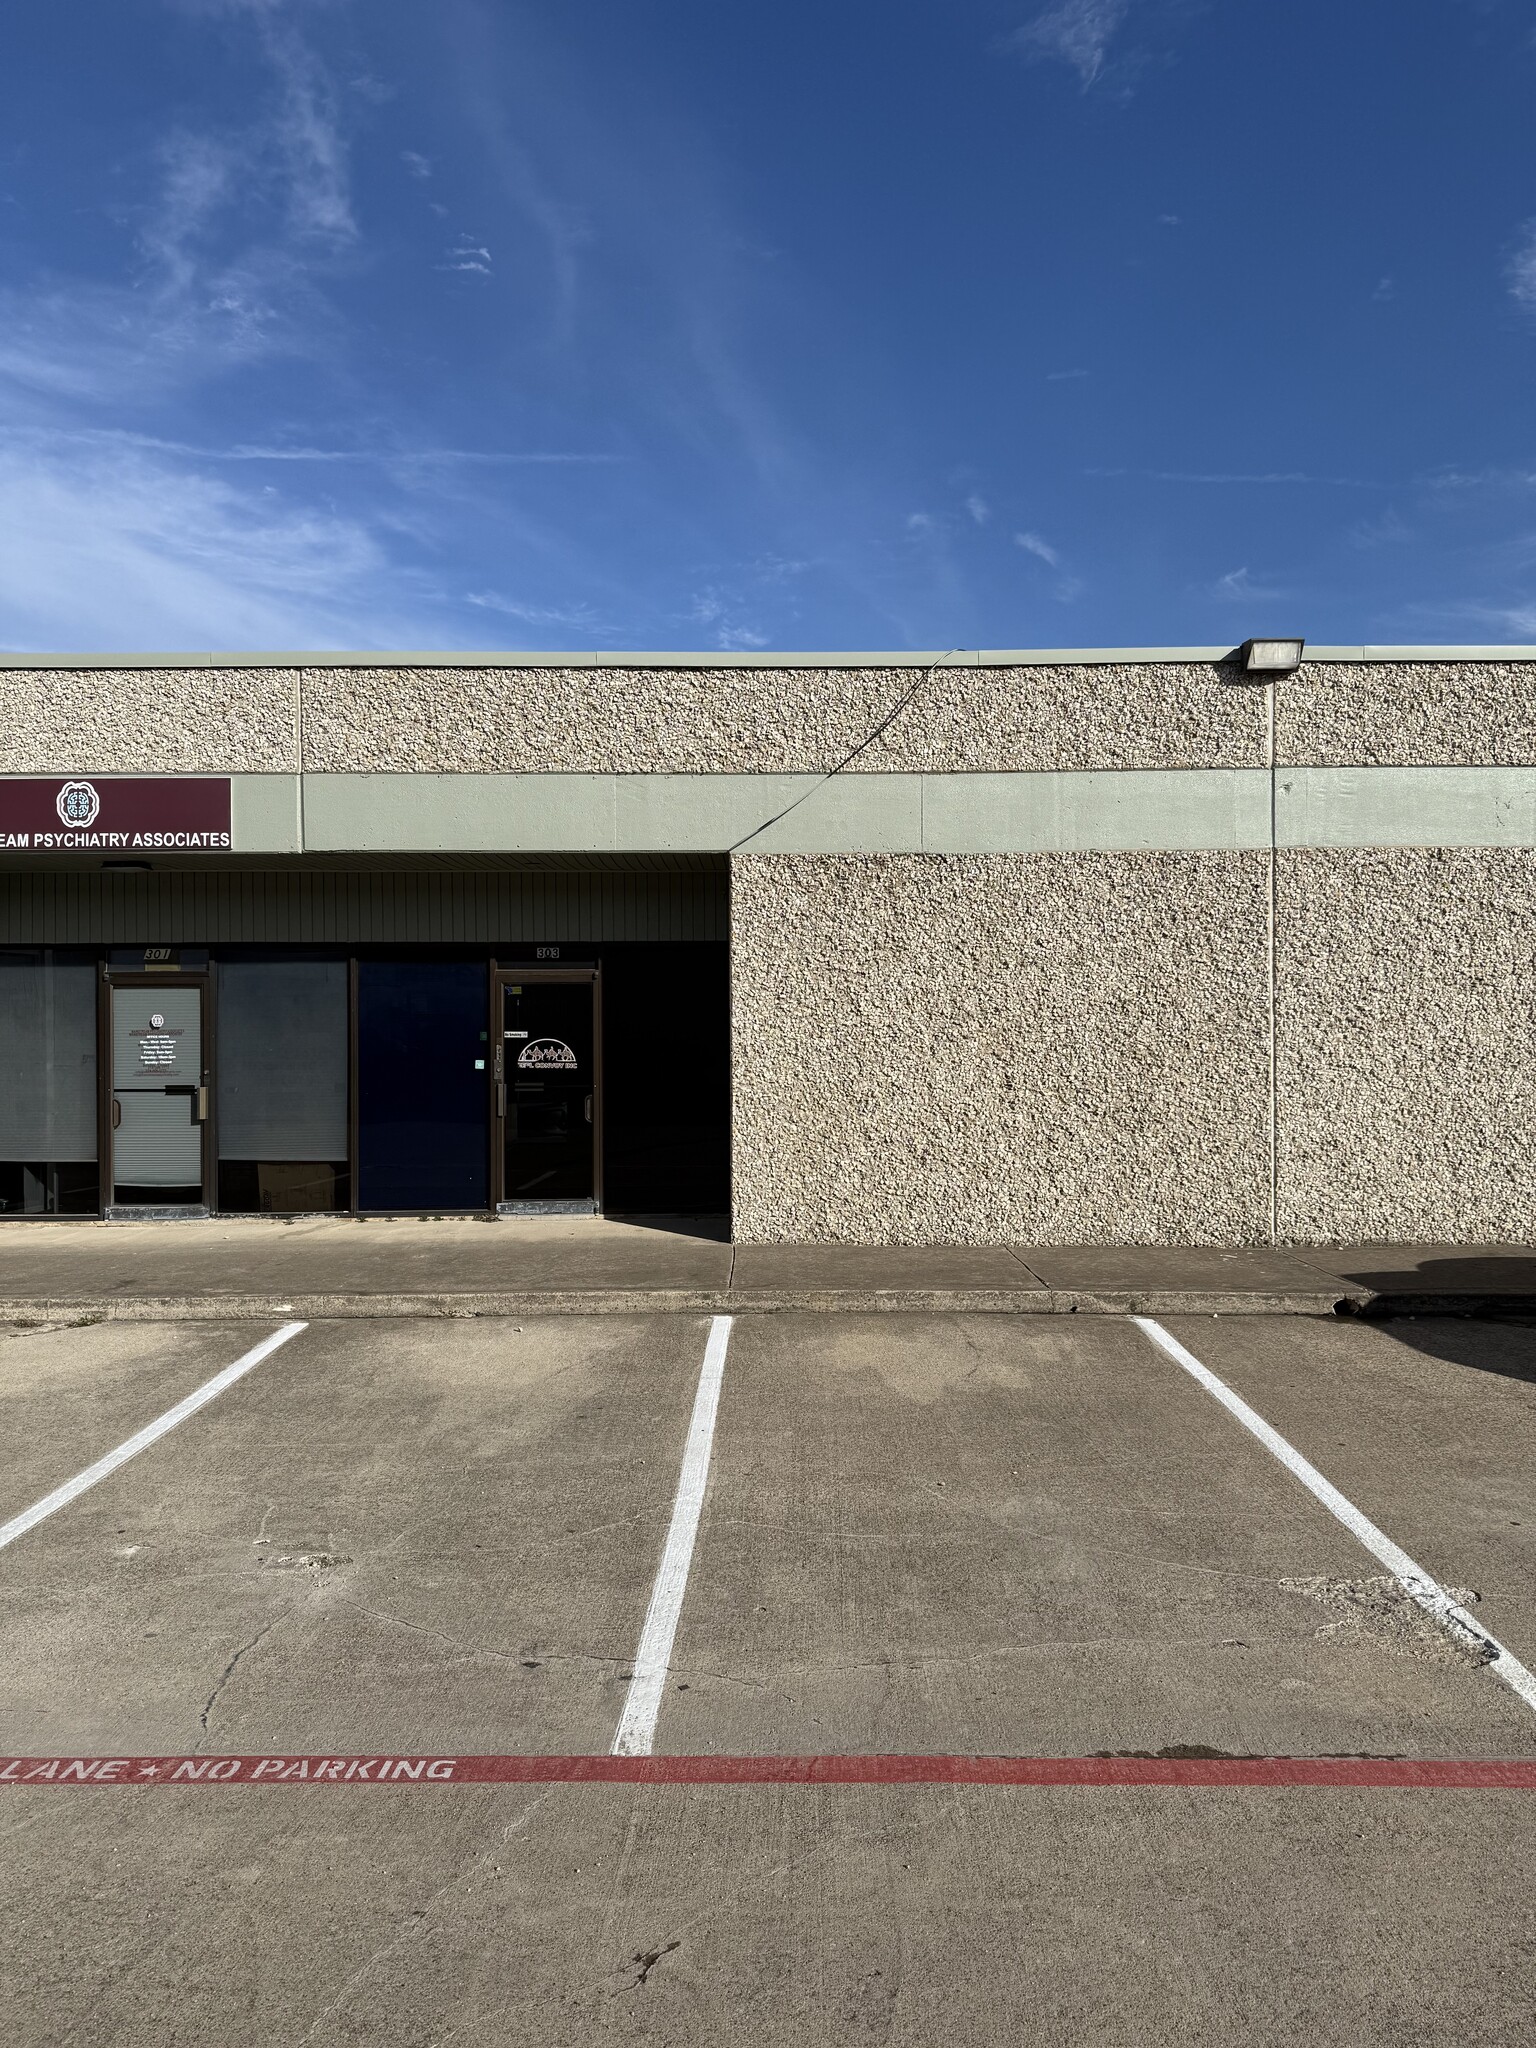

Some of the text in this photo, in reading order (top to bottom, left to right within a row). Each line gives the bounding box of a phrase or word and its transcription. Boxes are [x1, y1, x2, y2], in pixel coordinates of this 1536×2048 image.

[34, 832, 129, 847] PSYCHIATRY
[132, 832, 230, 847] ASSOCIATES
[145, 949, 169, 959] 301
[537, 948, 559, 958] 303
[0, 1759, 457, 1780] LANE NO PARKING
